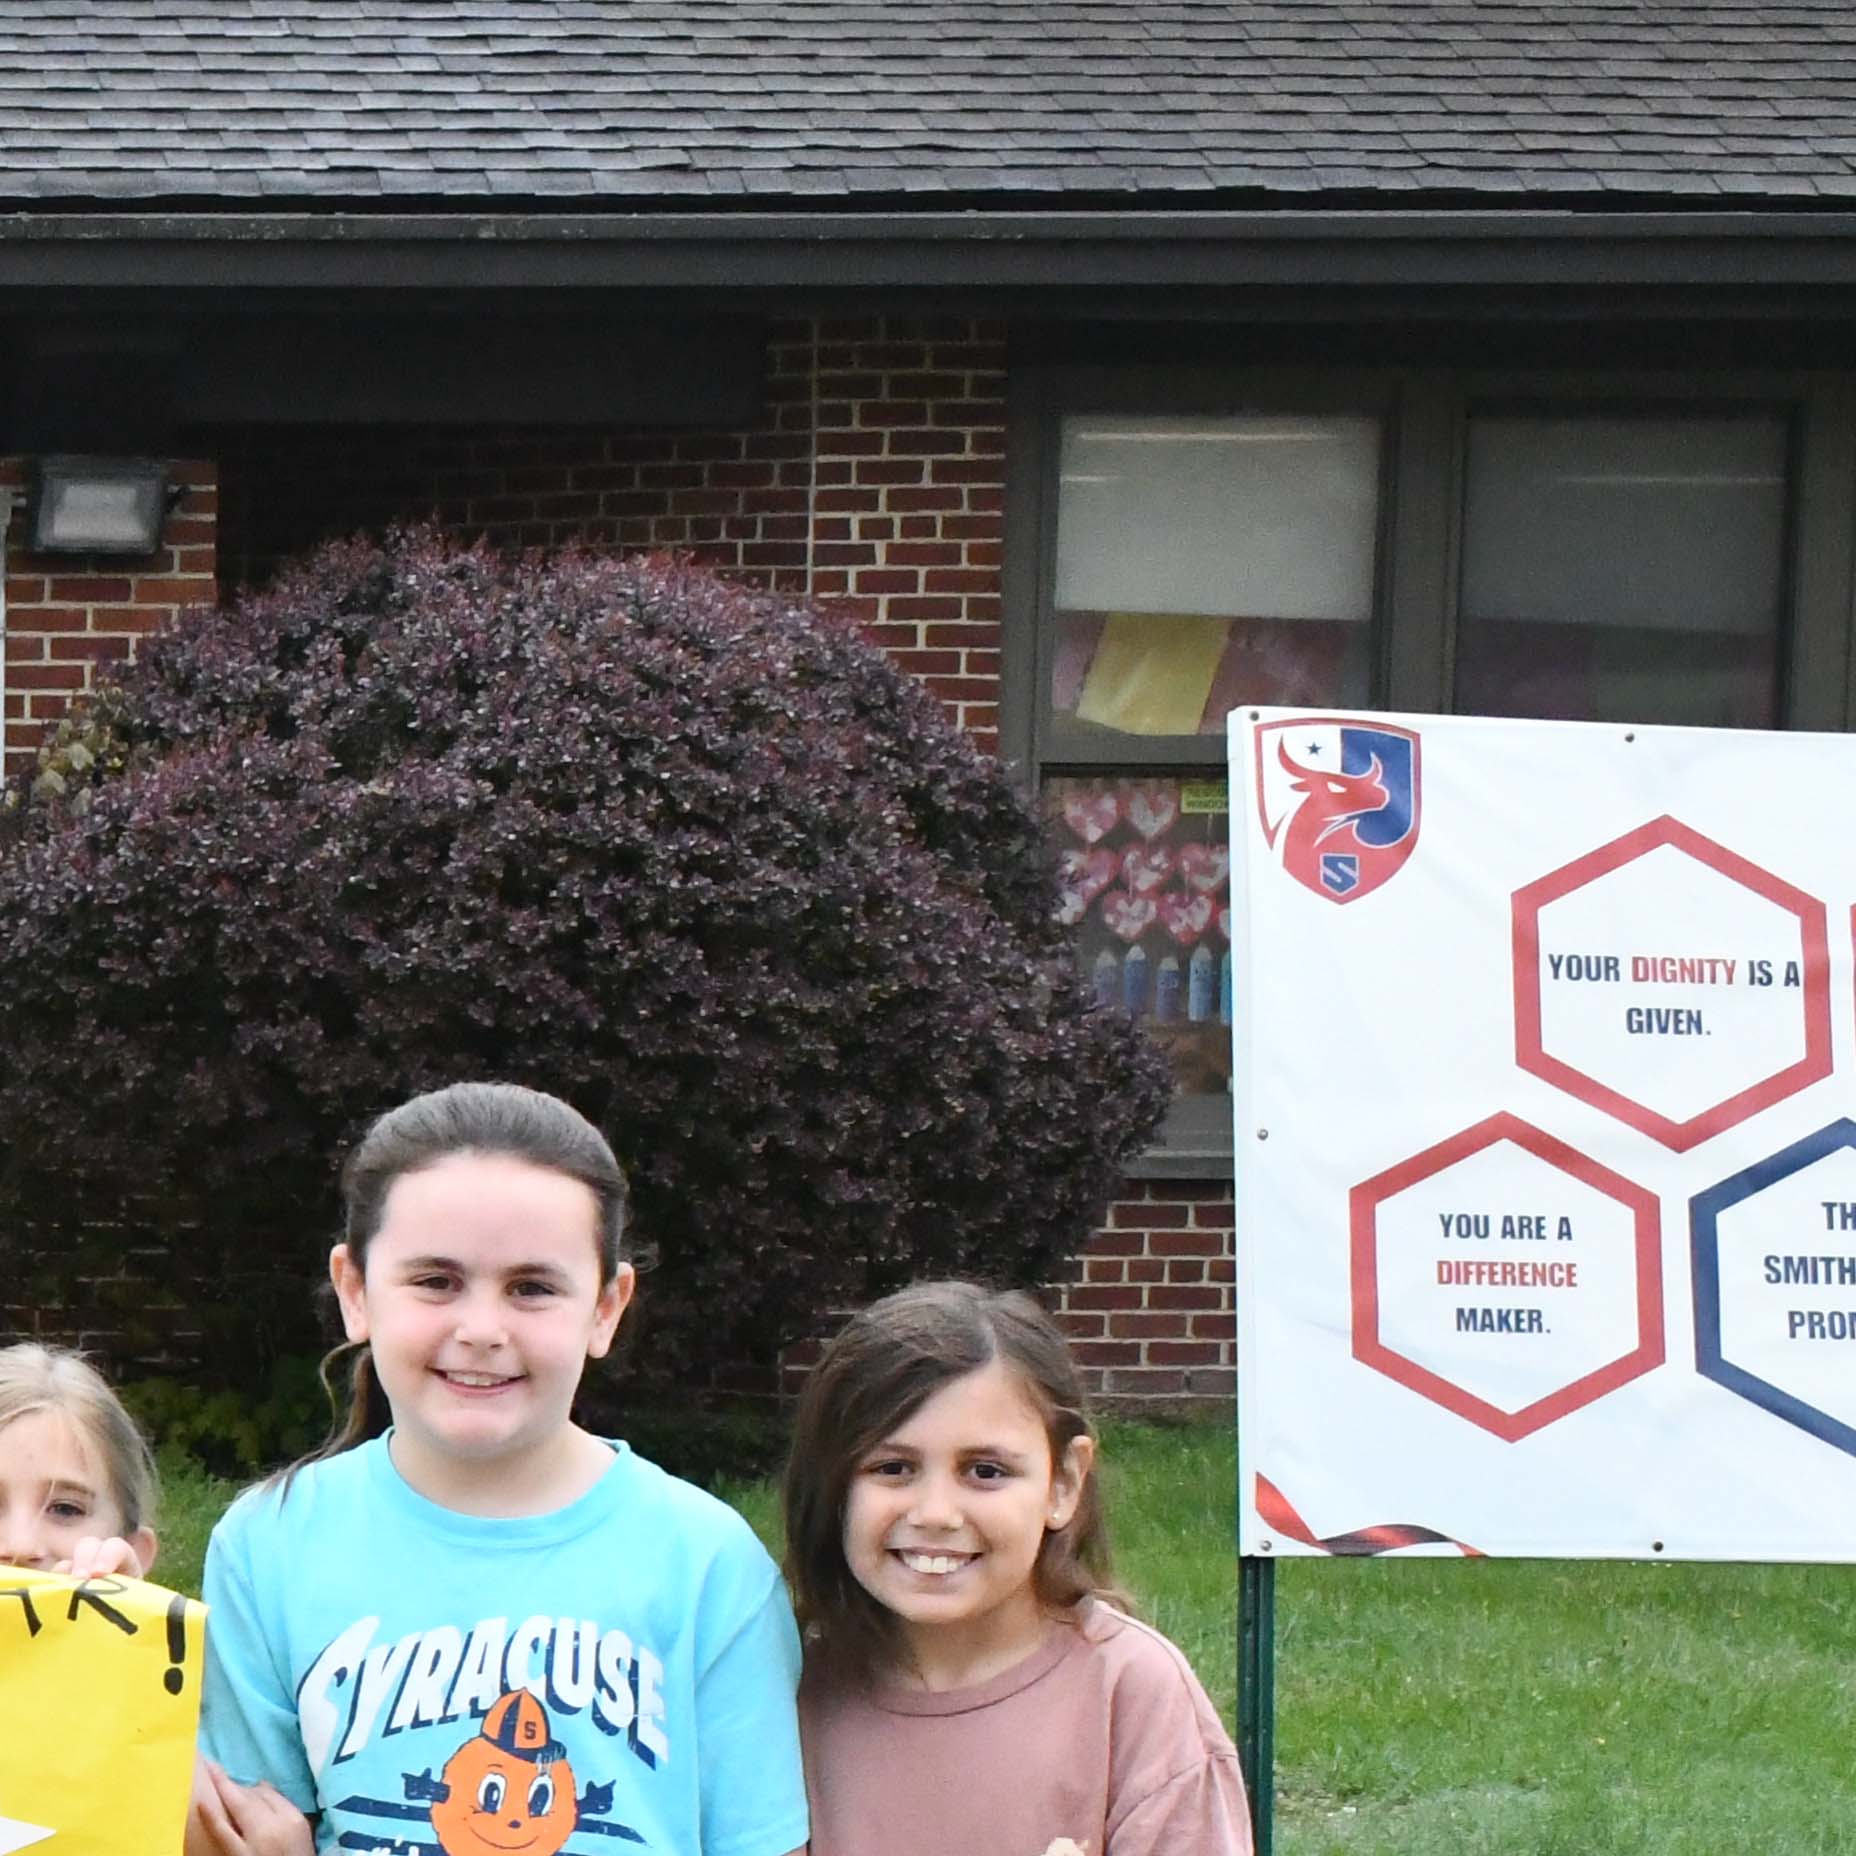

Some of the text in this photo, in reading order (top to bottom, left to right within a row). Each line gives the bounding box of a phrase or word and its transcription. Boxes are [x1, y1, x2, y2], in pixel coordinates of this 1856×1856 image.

[1548, 953, 1801, 988] YOUR DIGNITY IS A
[1626, 1007, 1712, 1036] GIVEN.
[1439, 1213, 1574, 1241] YOU ARE A
[1436, 1260, 1579, 1288] DIFFERENCE
[1455, 1307, 1552, 1335] MAKER.
[296, 1615, 670, 1795] SYRACUSE
[524, 1720, 537, 1740] S
